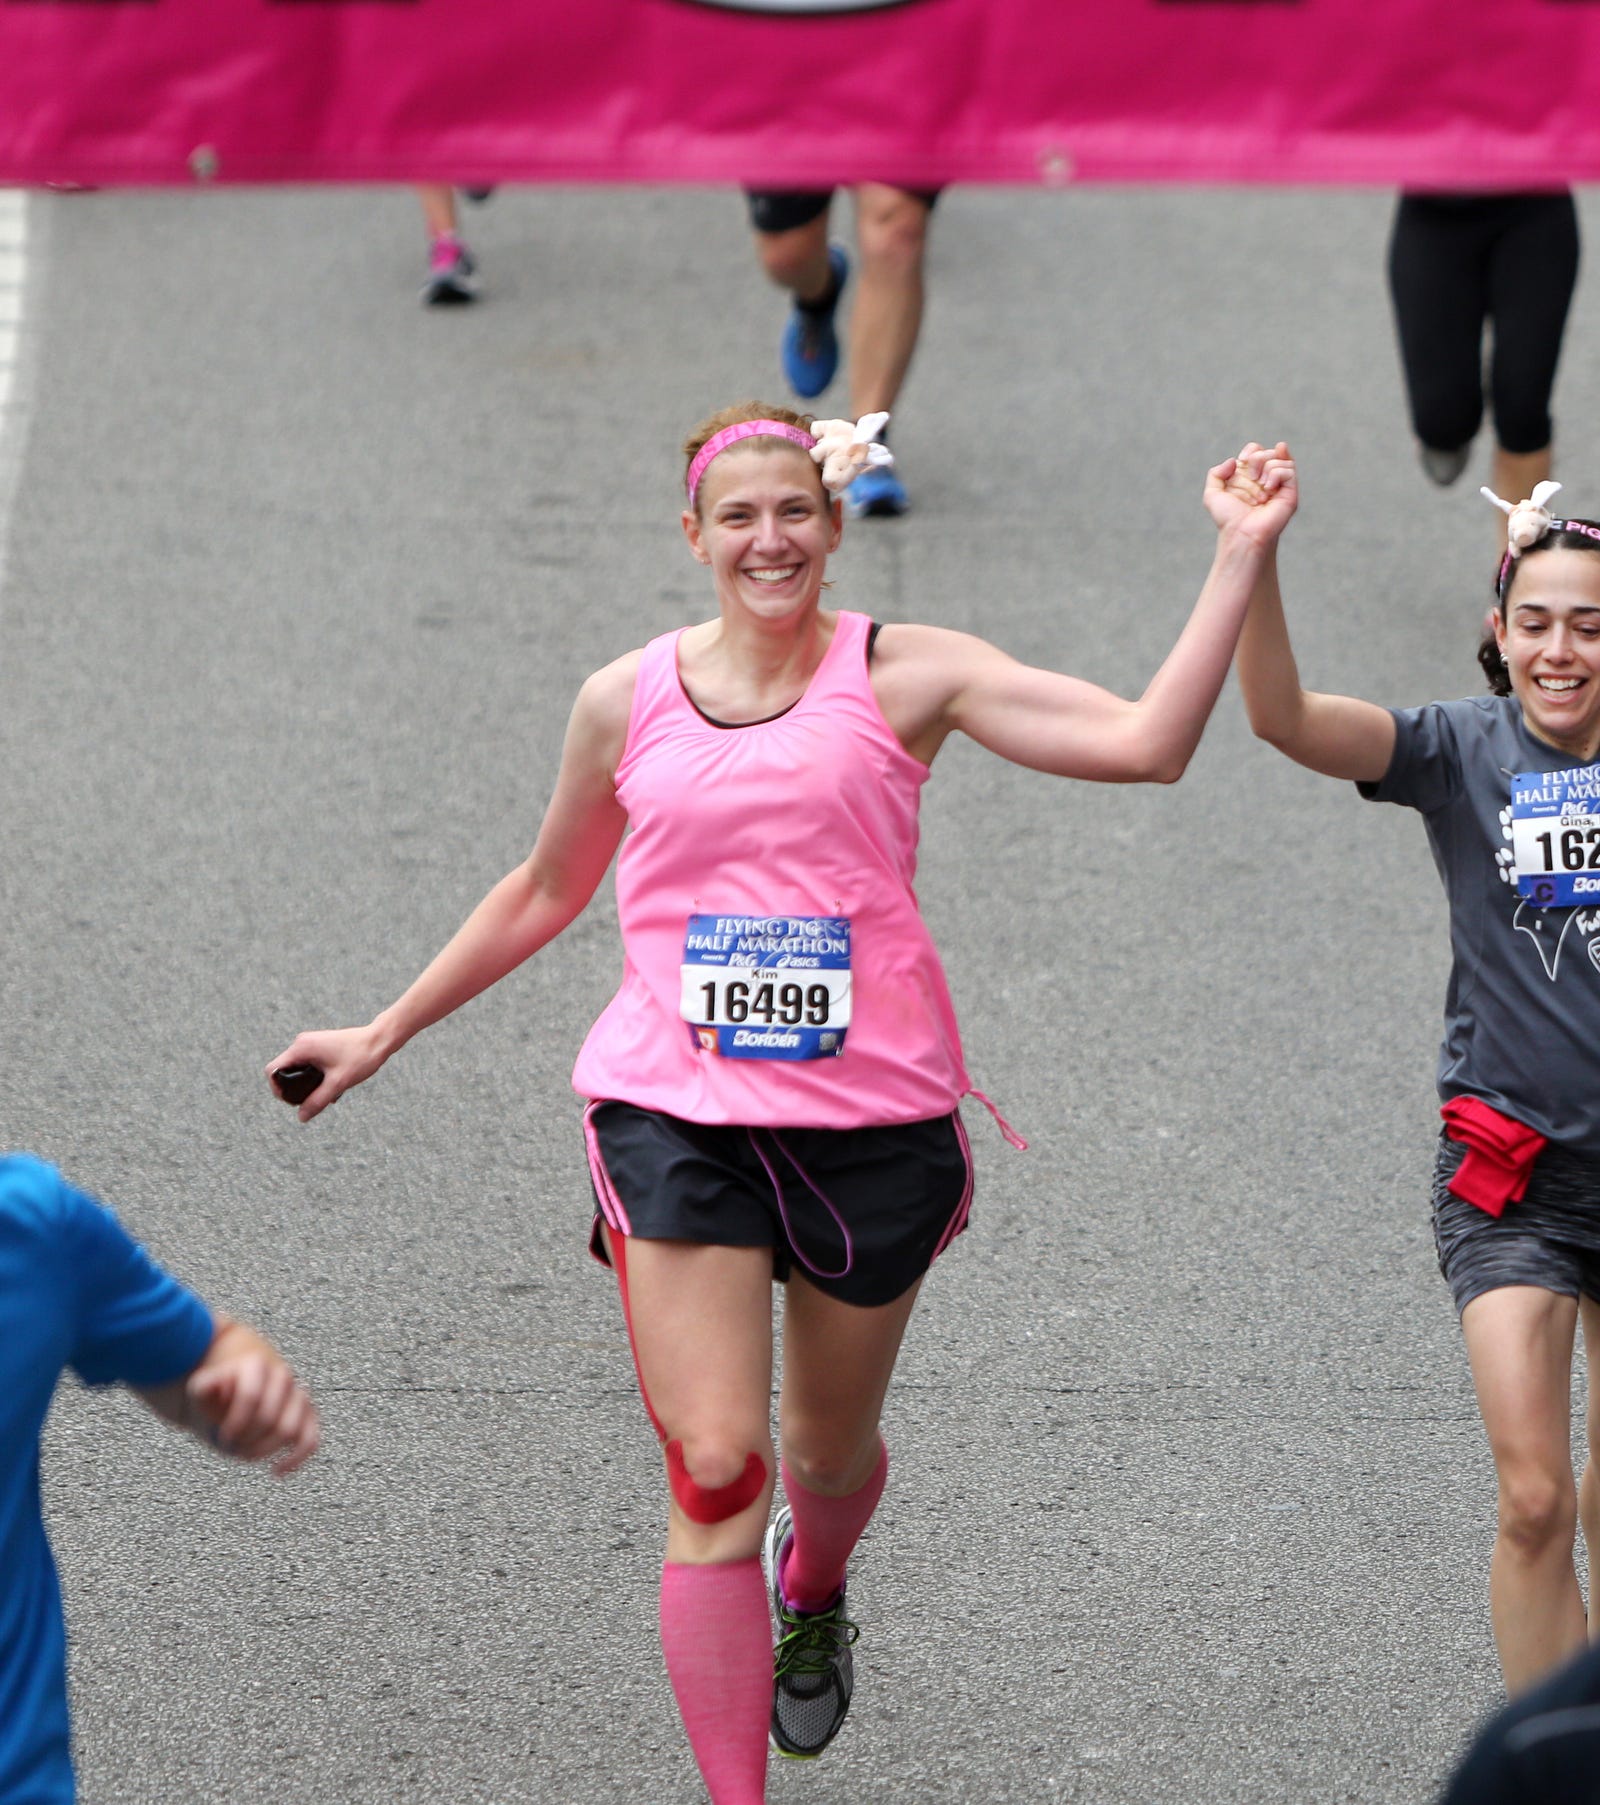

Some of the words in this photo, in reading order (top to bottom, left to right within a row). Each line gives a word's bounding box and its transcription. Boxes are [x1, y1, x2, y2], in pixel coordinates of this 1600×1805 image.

[1515, 786, 1562, 805] HALF
[1560, 801, 1589, 815] P&G
[1560, 815, 1595, 827] Gina,
[1535, 883, 1554, 902] C
[715, 918, 780, 934] FLYING
[788, 920, 819, 936] PIG
[687, 934, 731, 950] HALF
[736, 937, 848, 954] MARATHON
[728, 952, 759, 968] P&G
[751, 968, 778, 980] Kim
[700, 981, 830, 1025] 16499
[733, 1030, 801, 1048] BORDER
